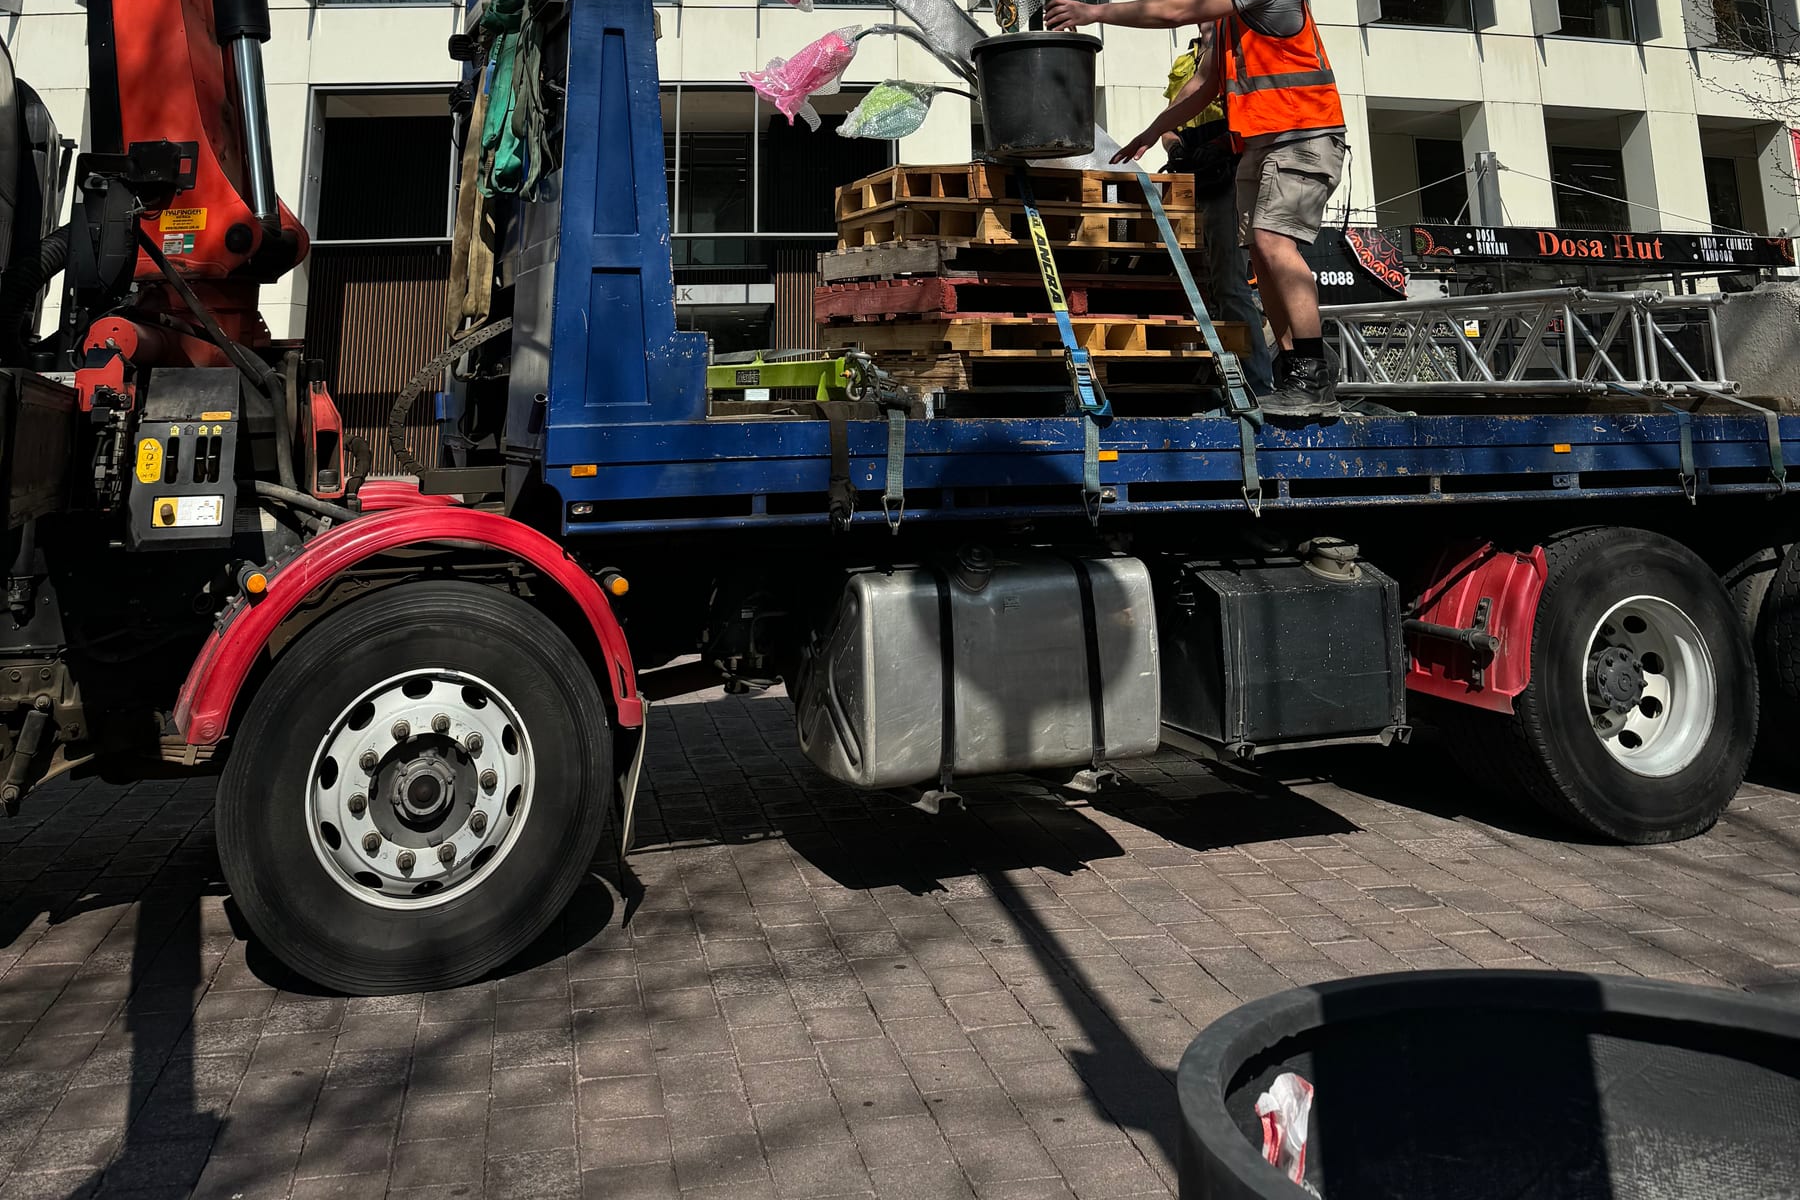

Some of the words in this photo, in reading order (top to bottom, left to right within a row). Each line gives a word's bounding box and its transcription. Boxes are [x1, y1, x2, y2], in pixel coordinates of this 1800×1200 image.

[1475, 229, 1496, 241] DOSA
[1477, 241, 1509, 255] BIRYANI
[1536, 231, 1605, 258] Dosa
[1612, 234, 1665, 260] Hut
[1726, 238, 1753, 251] CHINESE
[1701, 249, 1734, 262] TANDOOR
[1035, 232, 1062, 303] ANCRA
[1320, 271, 1354, 285] 8088
